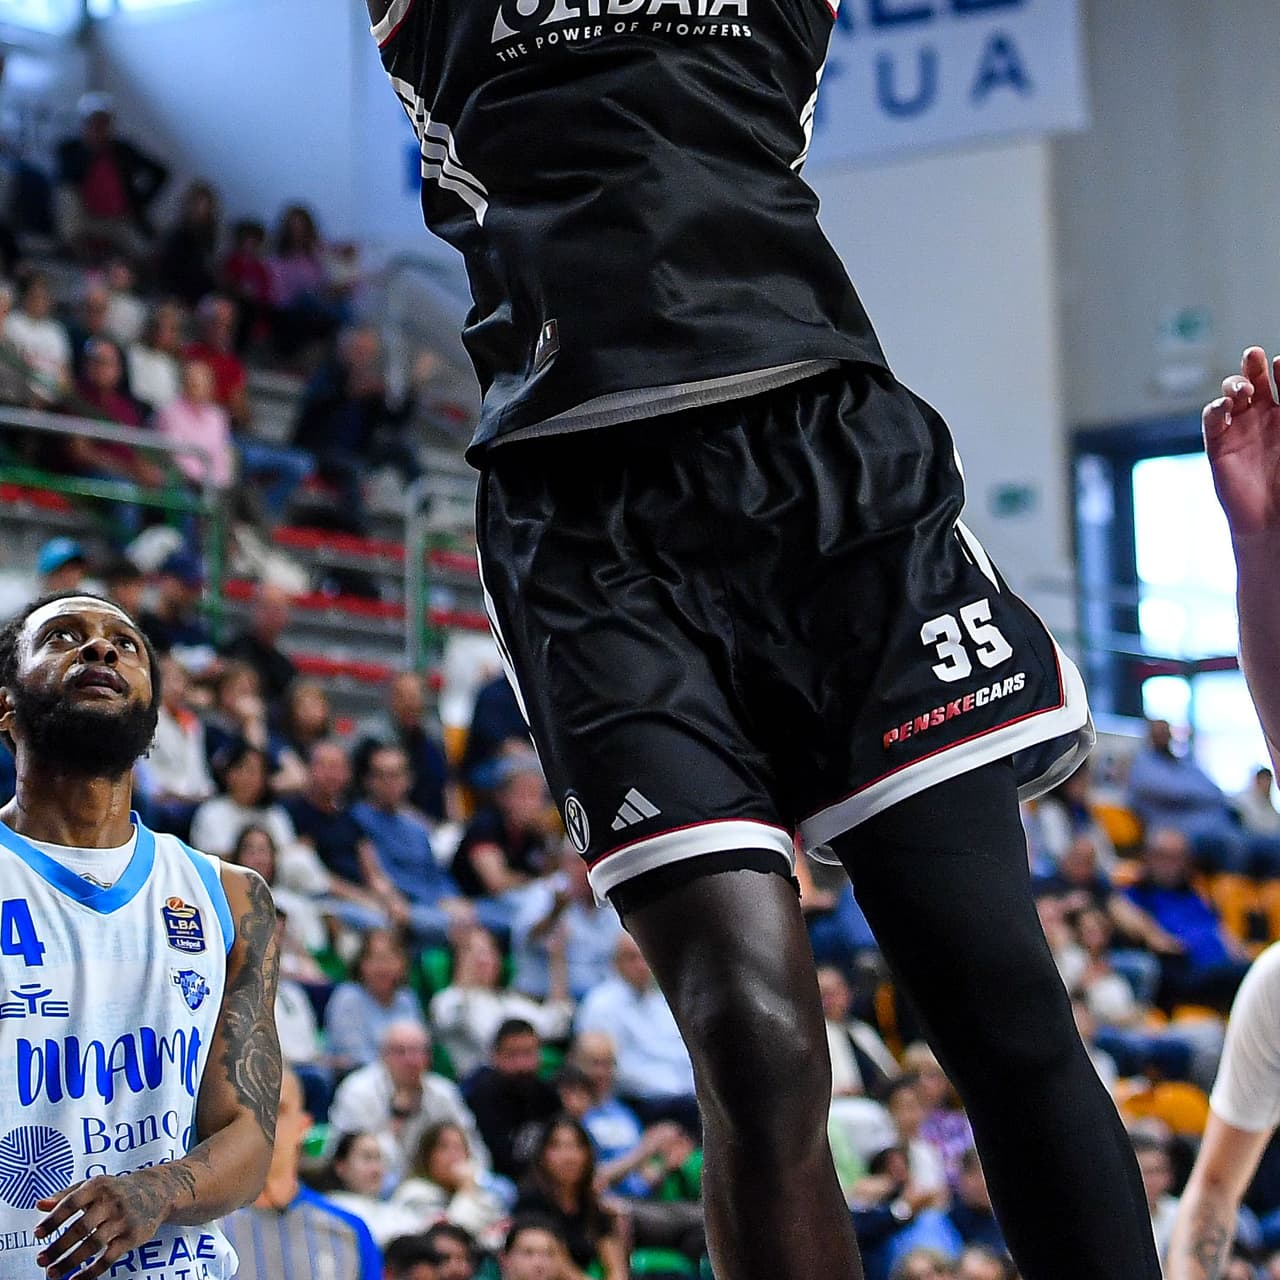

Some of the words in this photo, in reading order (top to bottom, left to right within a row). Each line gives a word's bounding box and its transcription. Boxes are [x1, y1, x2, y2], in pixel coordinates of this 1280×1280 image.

[496, 43, 528, 62] THE
[535, 25, 603, 49] POWER
[614, 22, 639, 33] OF
[652, 22, 753, 38] PIONEERS
[920, 598, 1013, 683] 35
[0, 898, 46, 967] 4
[169, 919, 200, 931] LBA
